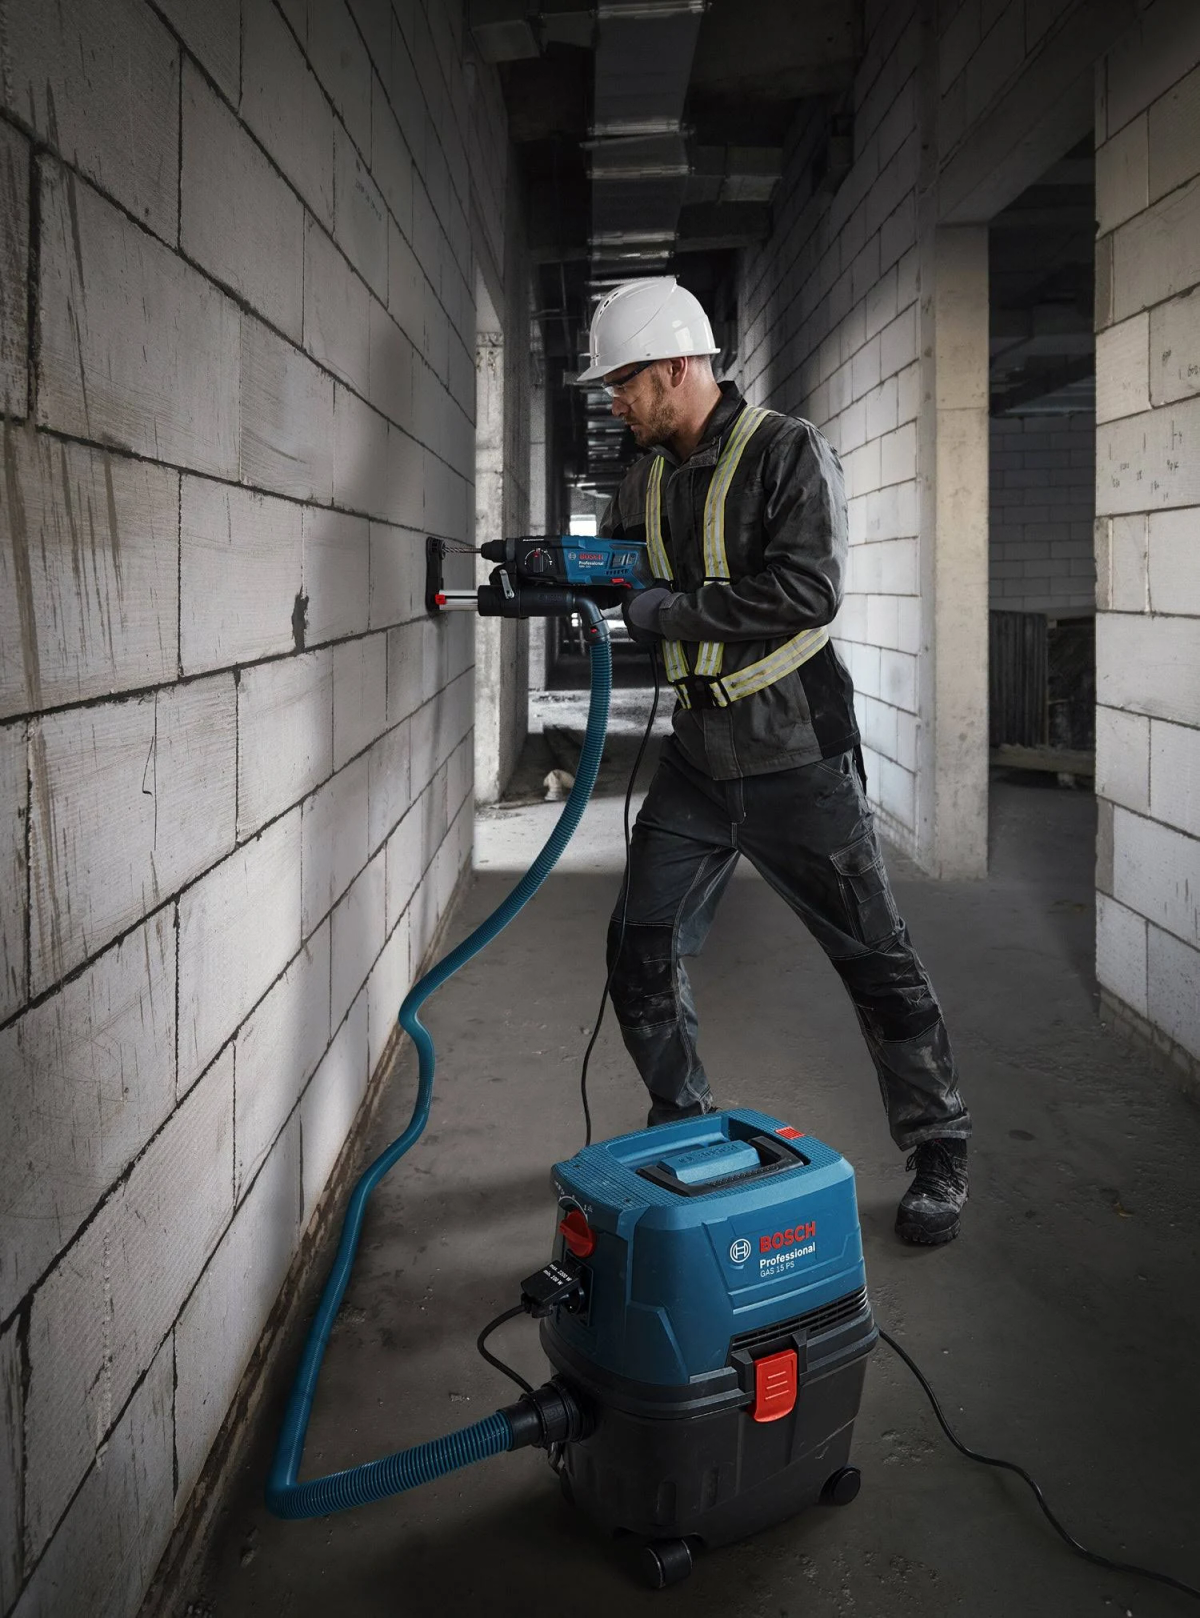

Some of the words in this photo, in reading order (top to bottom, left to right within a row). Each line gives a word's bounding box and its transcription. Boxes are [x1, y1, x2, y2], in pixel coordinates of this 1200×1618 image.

[759, 1221, 816, 1253] BOSCH
[759, 1242, 816, 1268] Professional
[760, 1266, 775, 1278] GAS
[776, 1264, 785, 1273] 15
[786, 1260, 795, 1270] PS
